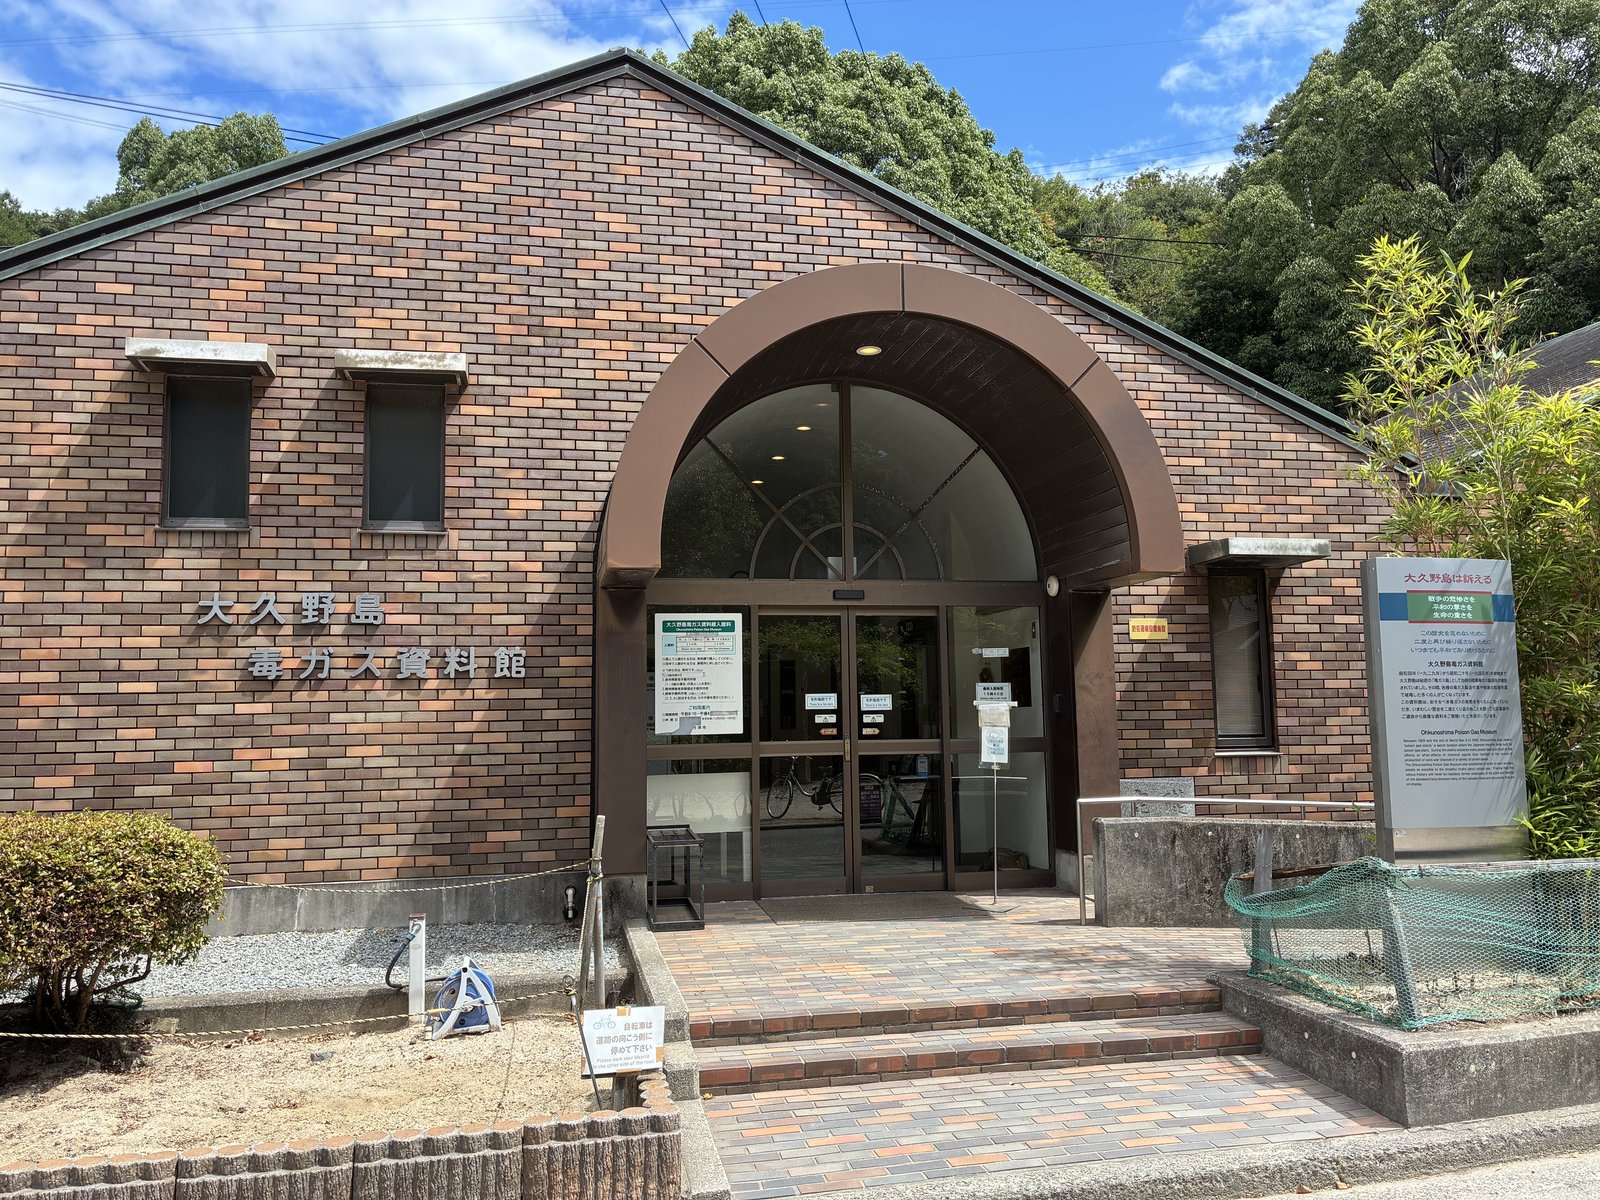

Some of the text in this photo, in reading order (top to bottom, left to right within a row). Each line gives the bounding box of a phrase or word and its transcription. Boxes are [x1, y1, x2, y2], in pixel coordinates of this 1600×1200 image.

[1404, 573, 1492, 584] 大久野島は訴える
[1428, 595, 1476, 603] 戦争の悲惨さを
[198, 592, 385, 625] 大久野島
[248, 646, 527, 680] 毒ガス資料館
[624, 1021, 653, 1031] 自転車は
[596, 1033, 653, 1045] 道路の向こう側に
[611, 1044, 652, 1055] 停めて下さい
